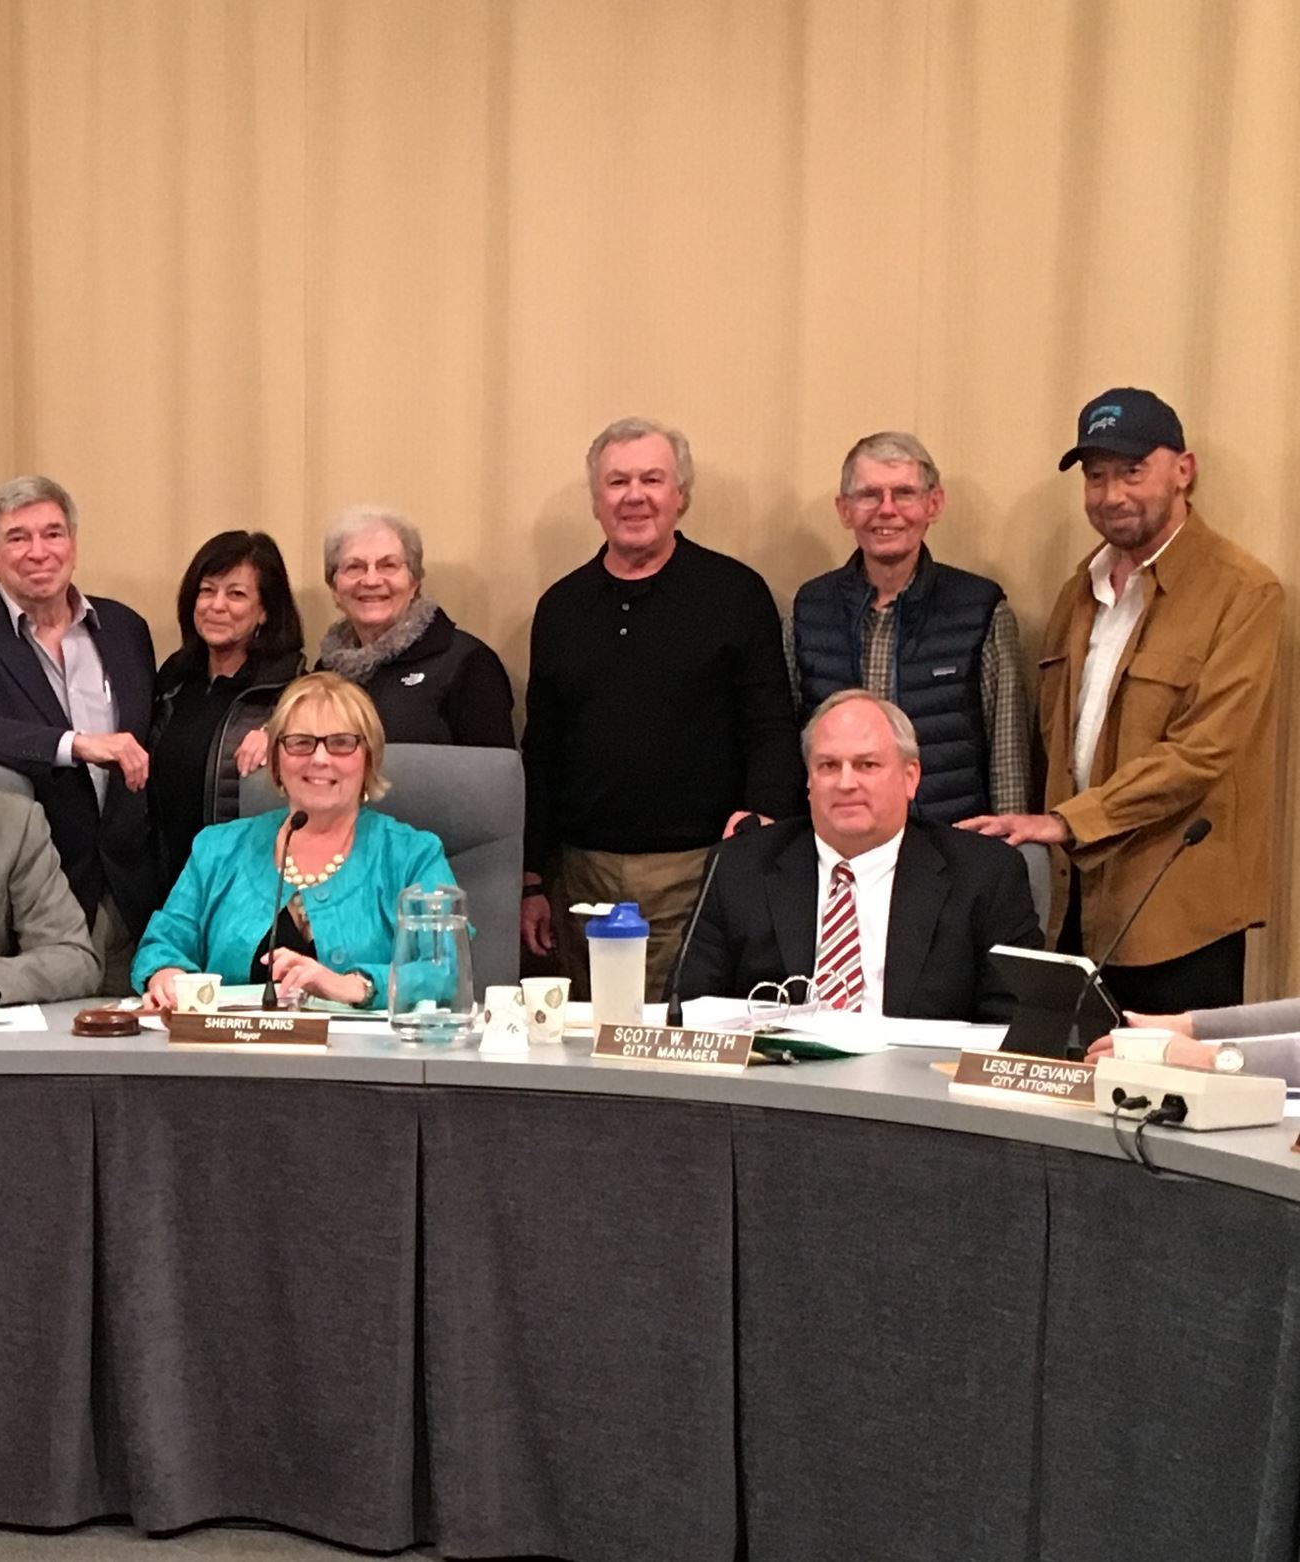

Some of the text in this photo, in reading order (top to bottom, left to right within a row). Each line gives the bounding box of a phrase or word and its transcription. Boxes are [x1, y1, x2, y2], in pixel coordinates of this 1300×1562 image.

[204, 1017, 294, 1031] SHERRYL PARKS
[234, 1030, 261, 1042] Mayor
[613, 1027, 737, 1050] SCOTT W. HUTH
[622, 1044, 719, 1062] CITY MANAGER
[982, 1058, 1092, 1084] LESLIE DEVANEY
[991, 1074, 1075, 1096] CITY ATTORNEY
